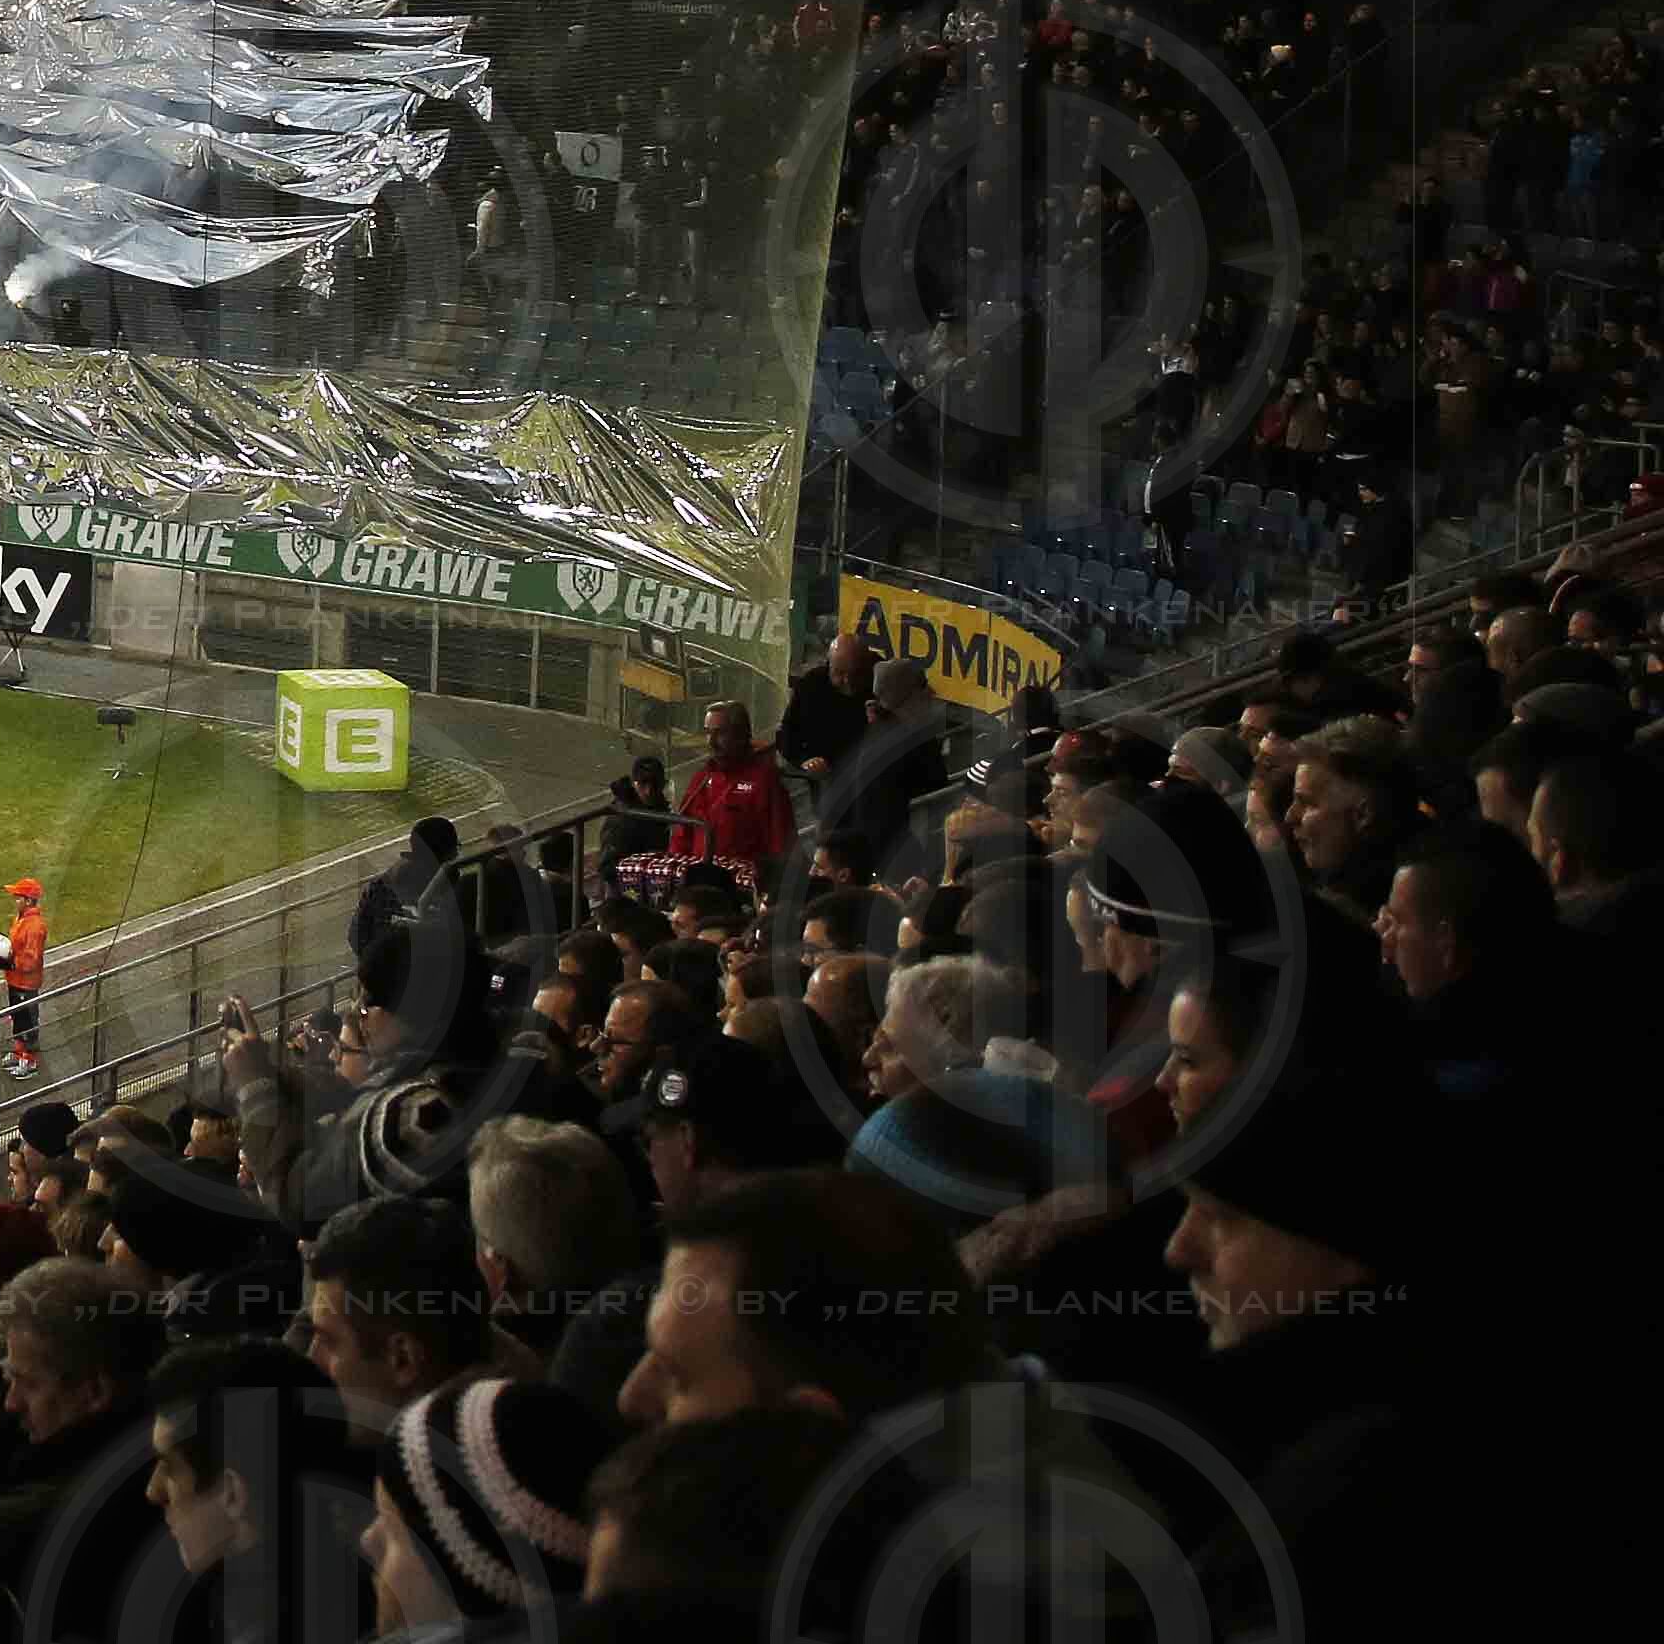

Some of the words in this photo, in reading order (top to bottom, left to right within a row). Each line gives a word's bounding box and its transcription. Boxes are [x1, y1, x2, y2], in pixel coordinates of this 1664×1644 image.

[77, 509, 238, 567] GRAWE
[341, 541, 514, 603] GRAWE
[625, 577, 790, 645] GRAWE
